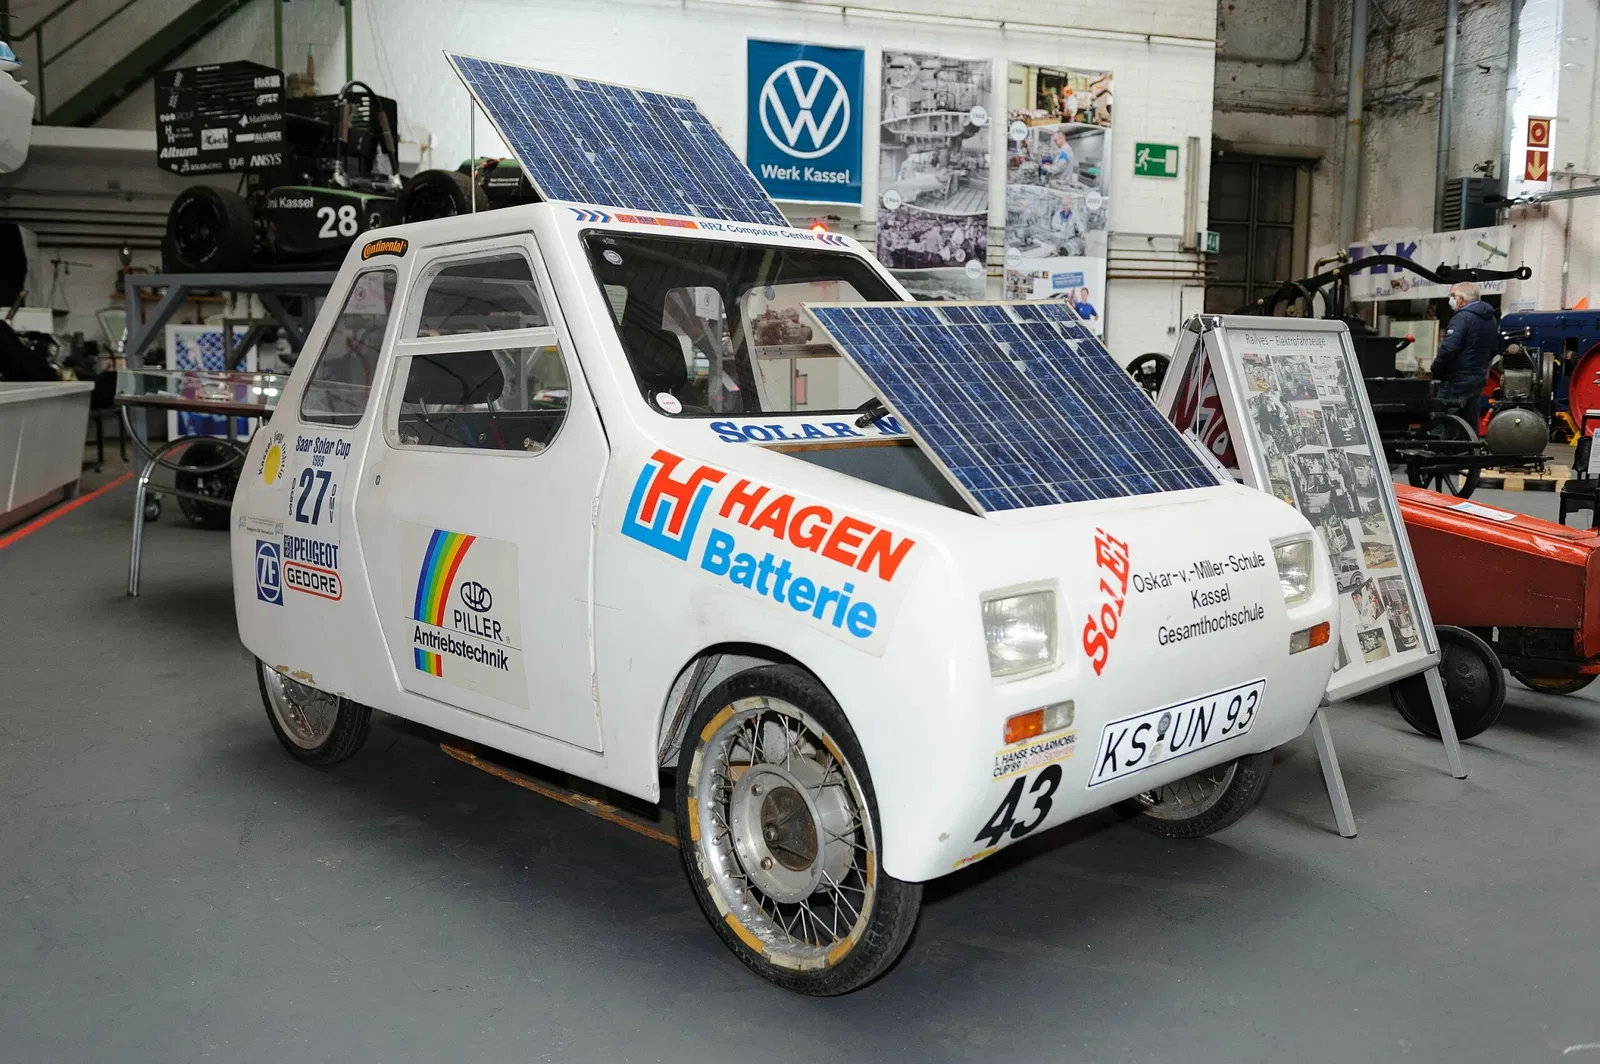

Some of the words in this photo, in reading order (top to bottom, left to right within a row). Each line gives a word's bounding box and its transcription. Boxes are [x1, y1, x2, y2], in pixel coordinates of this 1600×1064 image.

[160, 147, 198, 158] Altium
[250, 153, 282, 167] ANSYS
[761, 164, 800, 180] Werk
[804, 167, 850, 184] Kassel
[279, 197, 313, 208] Kassel
[316, 205, 358, 238] 28
[700, 221, 726, 231] RRZ
[726, 224, 779, 238] Computer
[780, 229, 815, 241] Center
[363, 240, 404, 258] Continental
[1245, 333, 1269, 347] Rallyes
[1275, 335, 1326, 348] Elektrofahrzeuge
[296, 435, 313, 453] Saar
[314, 436, 335, 456] Solar
[335, 438, 352, 460] Cup
[312, 455, 325, 467] 1989
[295, 467, 333, 525] 27
[719, 479, 916, 582] HAGEN
[293, 536, 339, 570] PEUGEOT
[259, 553, 279, 591] ZF
[287, 569, 337, 594] GEDORE
[700, 528, 878, 638] Batterie
[1132, 551, 1266, 593] Oskar-v.-Miller-Schule
[1190, 583, 1231, 609] Kassel
[454, 609, 503, 642] PILLER
[1157, 602, 1265, 646] Gesamthochschule
[413, 625, 509, 671] Antriebstechnik
[1221, 689, 1258, 735] 93
[1002, 748, 1028, 764] HANSE
[973, 763, 1062, 849] 43
